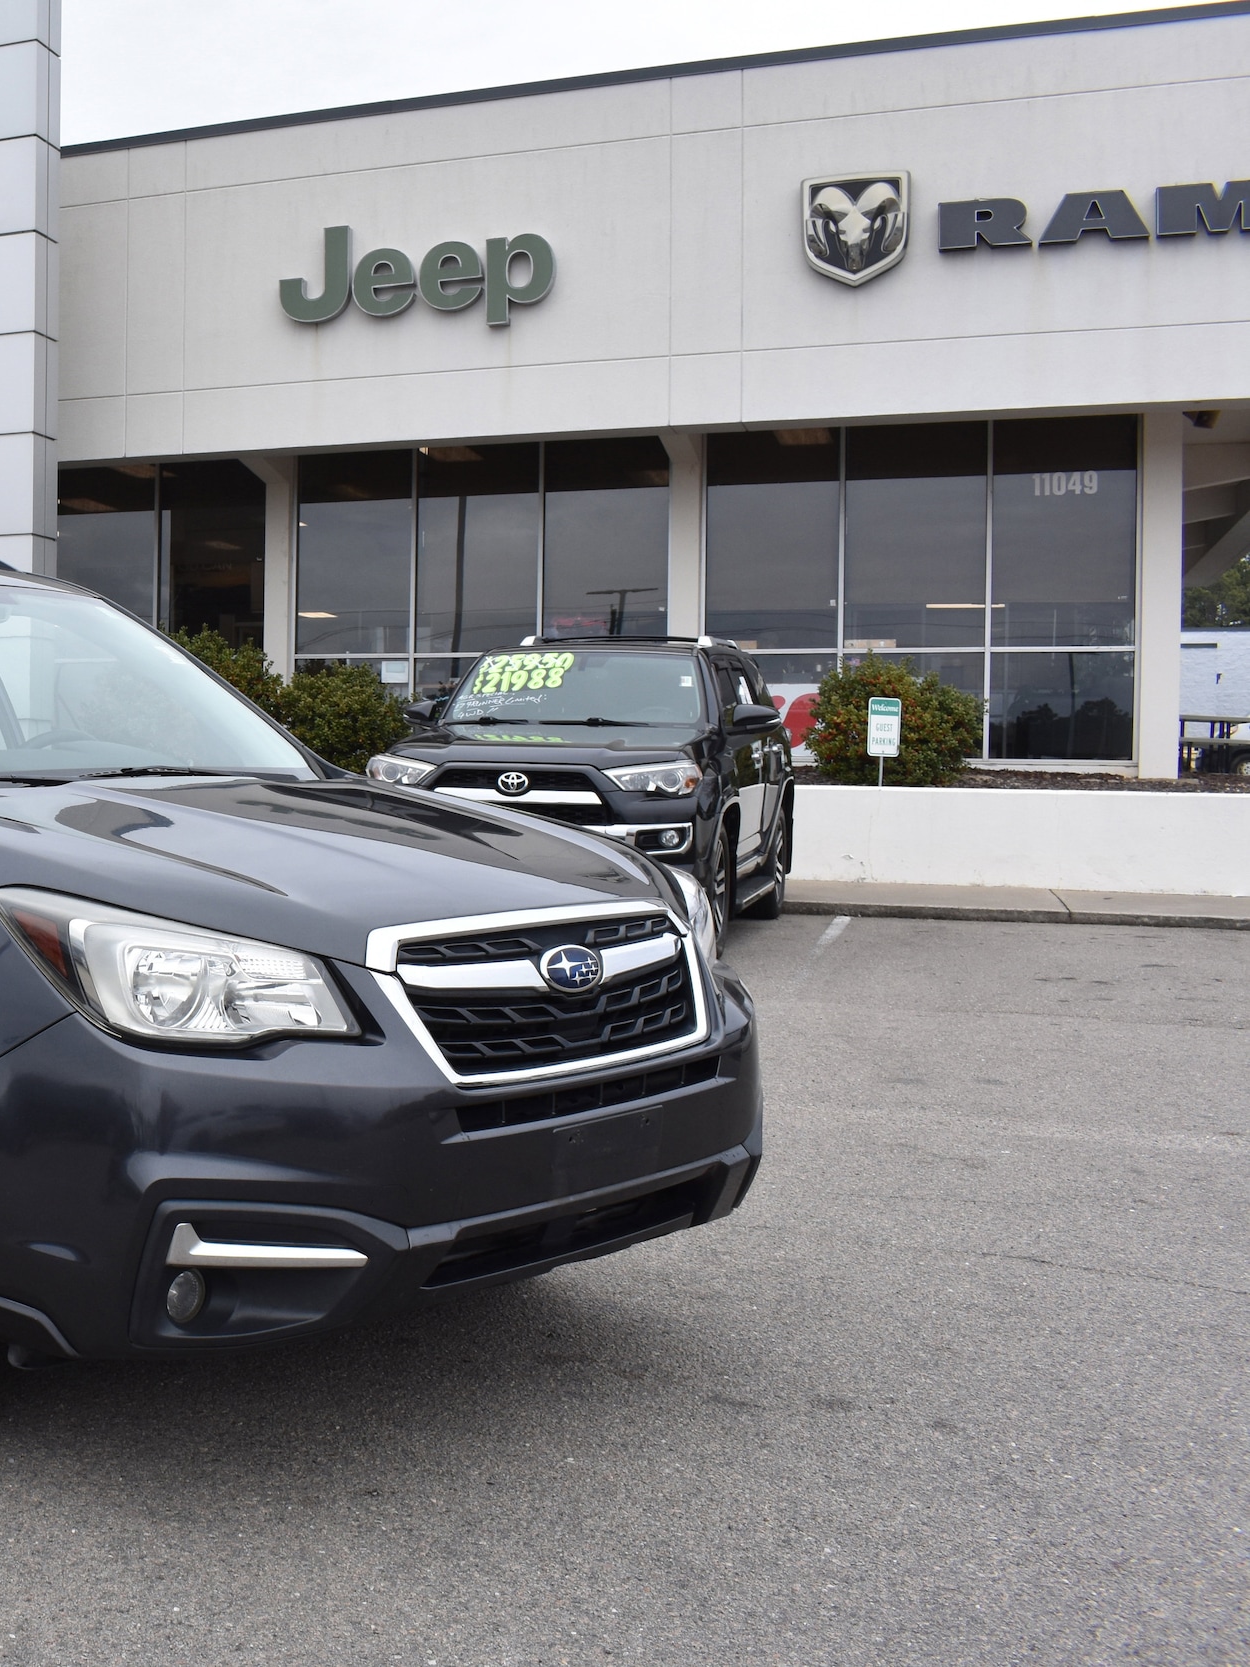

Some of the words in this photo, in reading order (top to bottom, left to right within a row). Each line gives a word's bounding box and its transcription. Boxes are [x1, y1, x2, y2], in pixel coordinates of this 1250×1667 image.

[938, 179, 1250, 252] RAM
[279, 225, 556, 327] Jeep
[1032, 470, 1098, 496] 11049
[473, 667, 565, 693] $21988
[872, 704, 899, 713] Welcome
[876, 723, 893, 732] GUEST
[872, 737, 896, 746] PARKING
